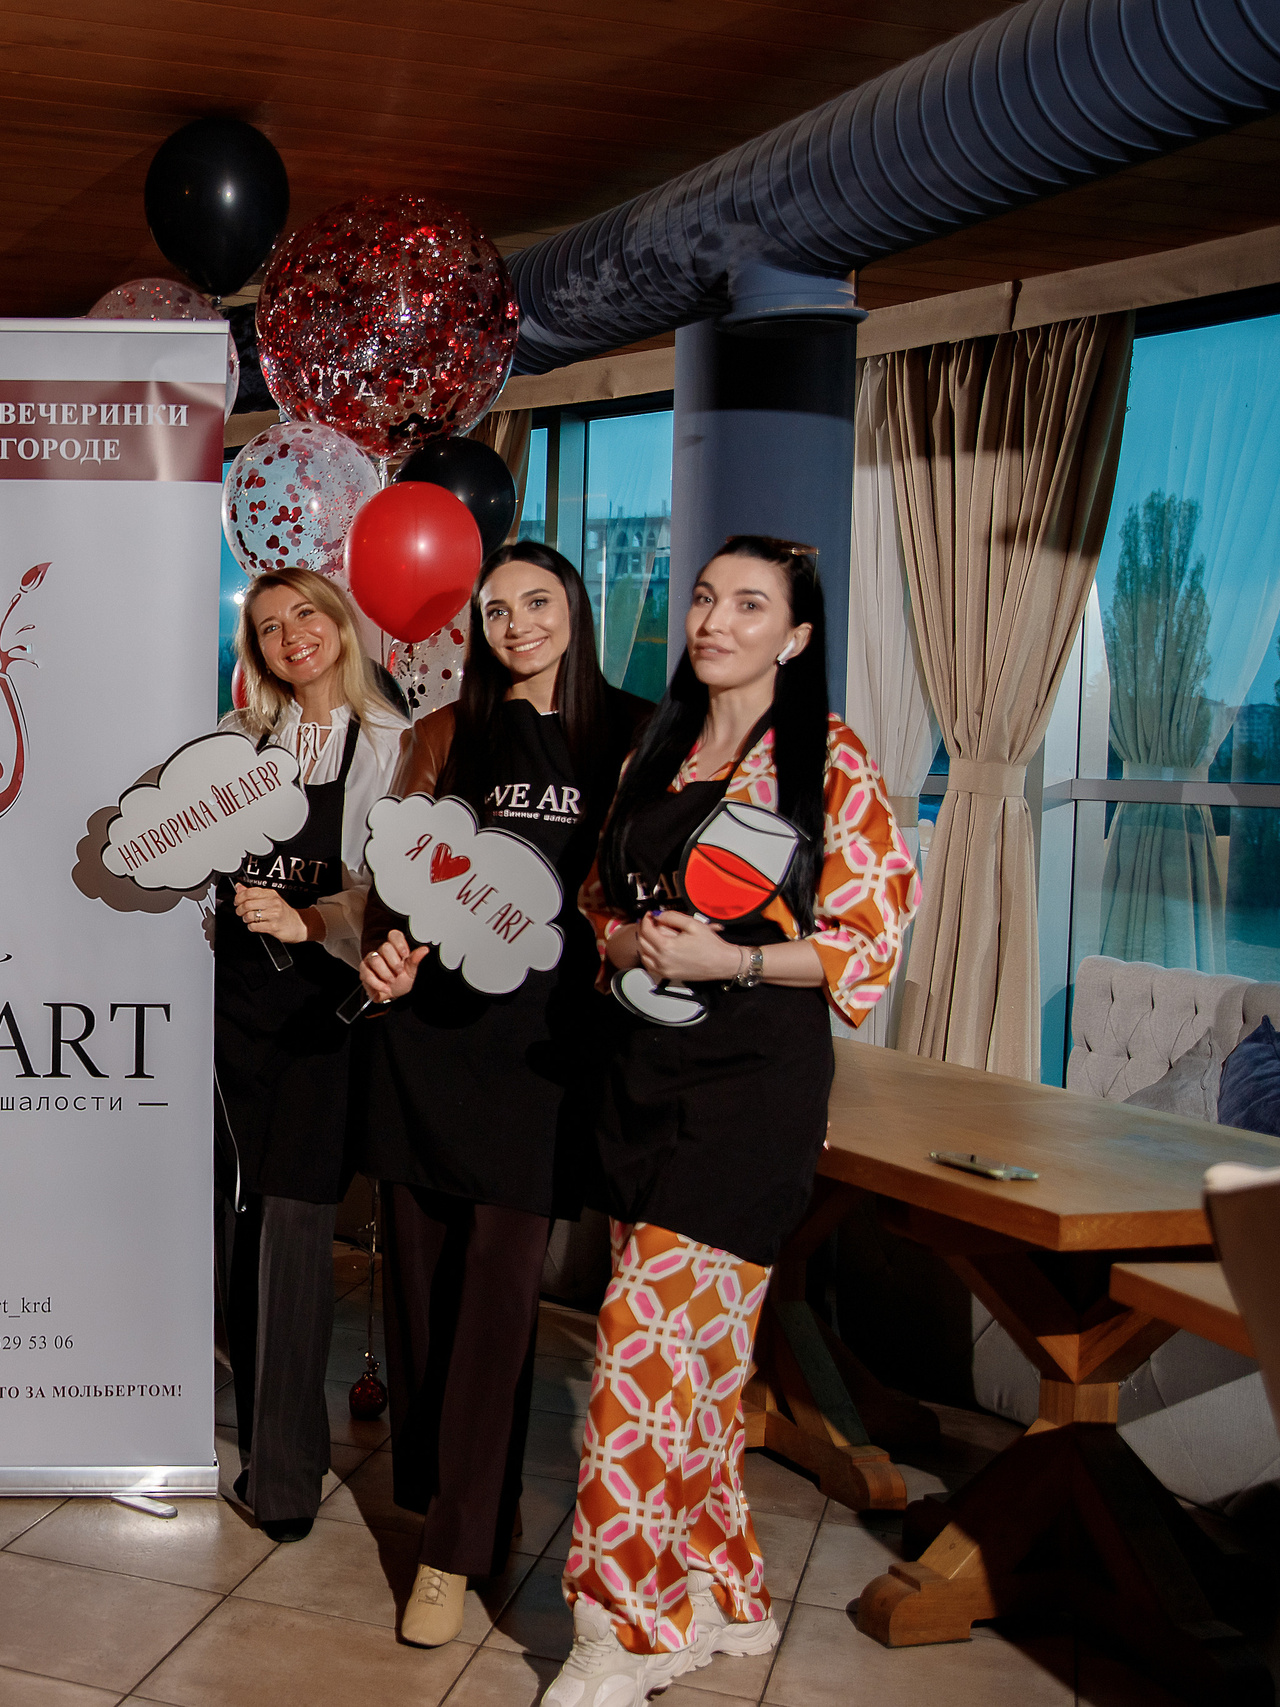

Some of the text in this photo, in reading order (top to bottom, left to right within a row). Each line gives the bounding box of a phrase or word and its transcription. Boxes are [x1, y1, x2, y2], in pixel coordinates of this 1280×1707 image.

[210, 760, 282, 817] ШЕДЕВР
[266, 855, 328, 885] ART
[405, 833, 535, 945] Я WE ART
[0, 1096, 122, 1112] шалости
[28, 1335, 47, 1350] 53
[54, 1335, 74, 1350] 06
[25, 1386, 46, 1399] ЗА
[52, 1384, 182, 1398] МОЛЬБЕРТОМ!
